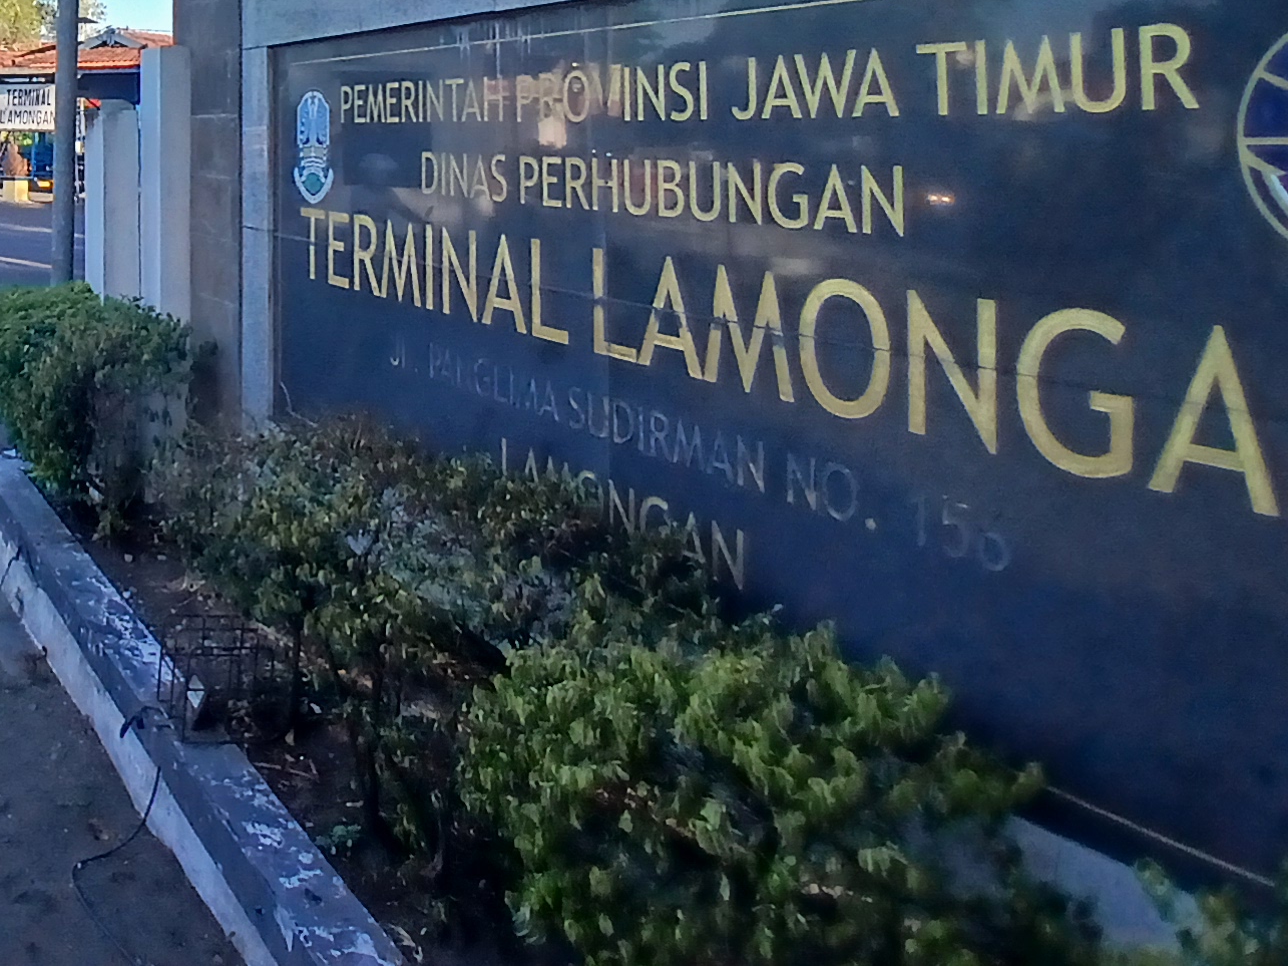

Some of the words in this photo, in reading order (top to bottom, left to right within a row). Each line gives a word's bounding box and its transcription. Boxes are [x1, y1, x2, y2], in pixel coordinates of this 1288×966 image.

[7, 89, 52, 106] TERMINAL
[340, 76, 504, 124] PEMERINTAH
[516, 60, 708, 123] PROVINSI
[732, 47, 900, 121] JAWA
[916, 22, 1200, 115] TIMUR
[420, 151, 507, 203] DINAS
[519, 155, 905, 237] PERHUBUNGAN
[300, 207, 569, 345] TERMINAL
[592, 248, 1279, 516] LAMONGA
[567, 385, 766, 494] SUDIRMAN
[786, 451, 877, 531] NO.
